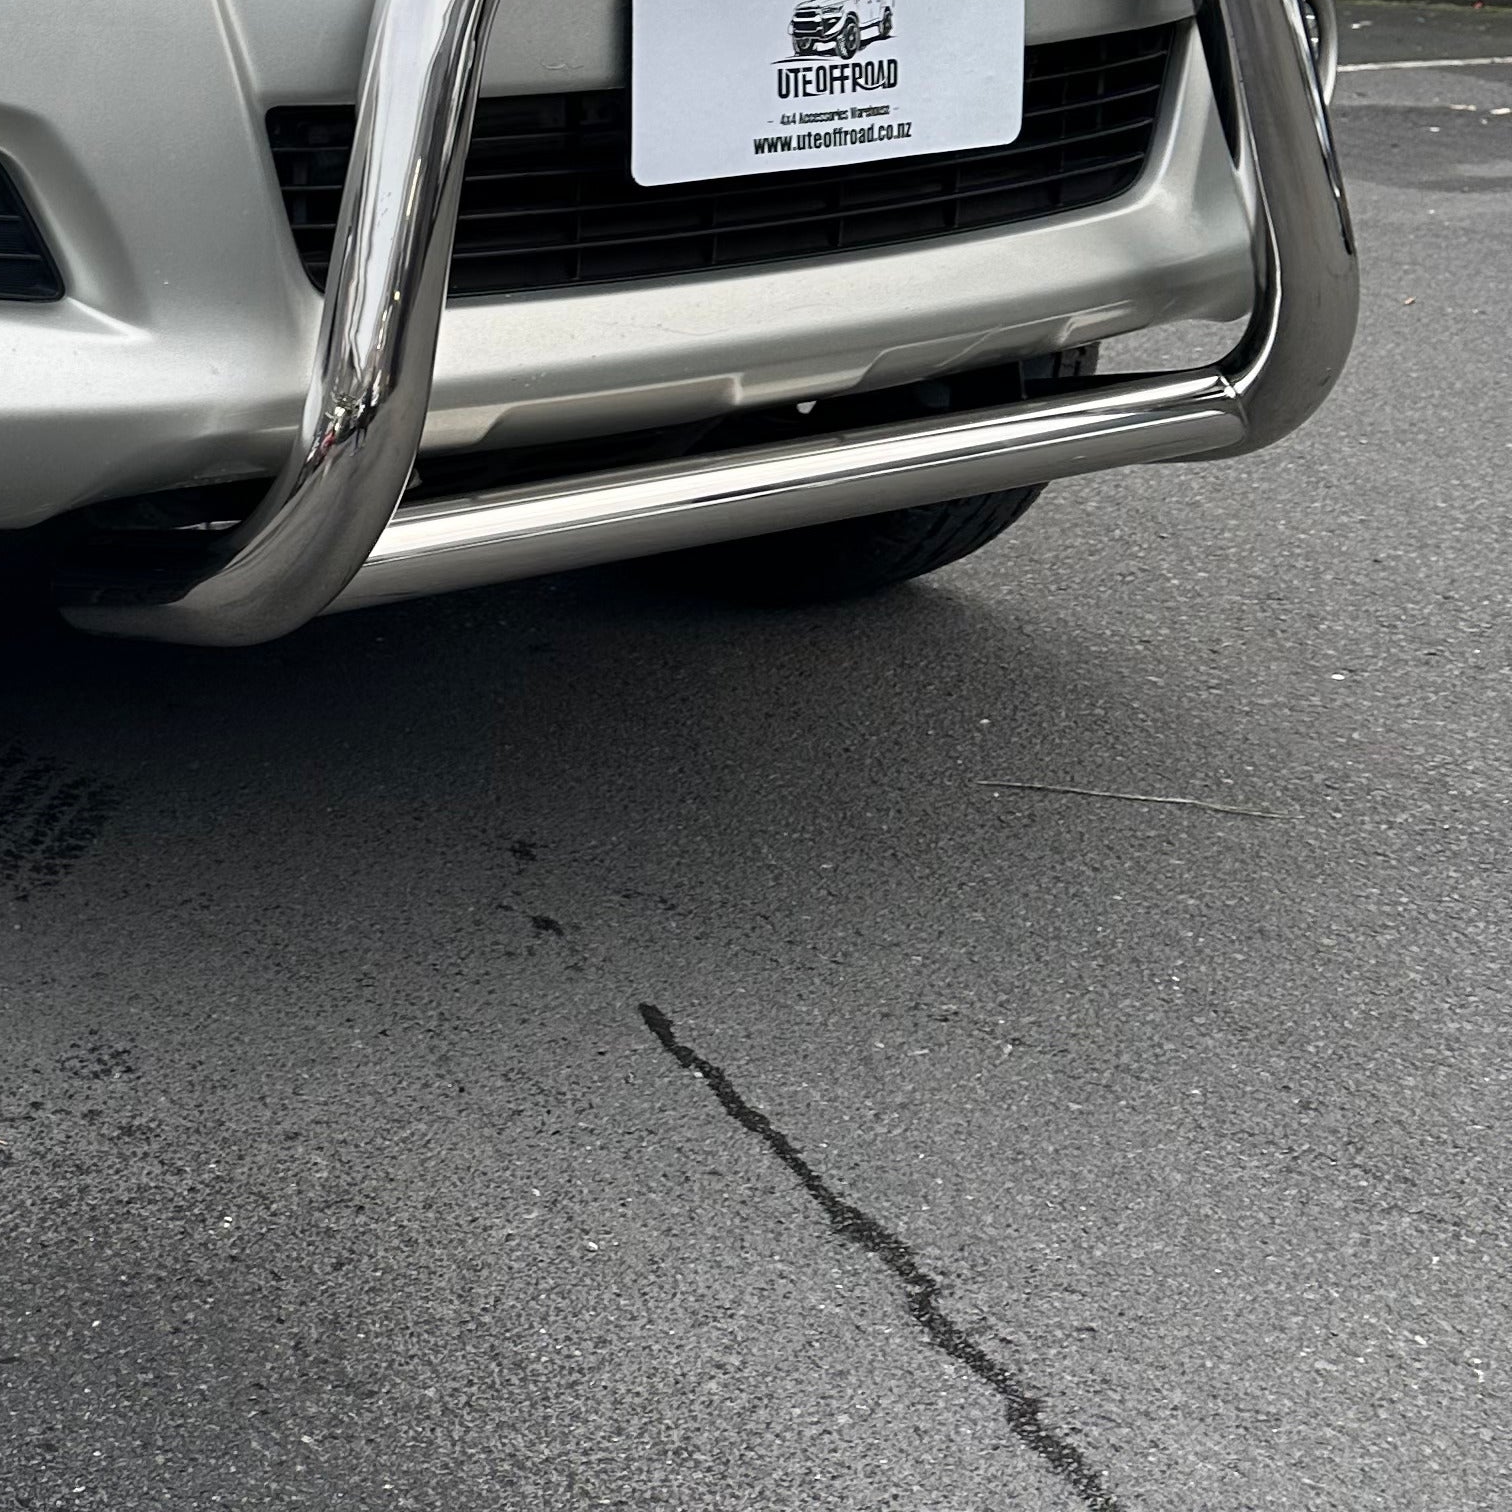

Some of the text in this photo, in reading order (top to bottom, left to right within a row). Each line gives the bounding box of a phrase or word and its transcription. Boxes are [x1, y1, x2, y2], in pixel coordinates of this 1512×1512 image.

[777, 58, 898, 99] UTEOFFROAD
[779, 113, 797, 126] 4x4
[753, 121, 912, 155] www.uteoffroad.co.nz
